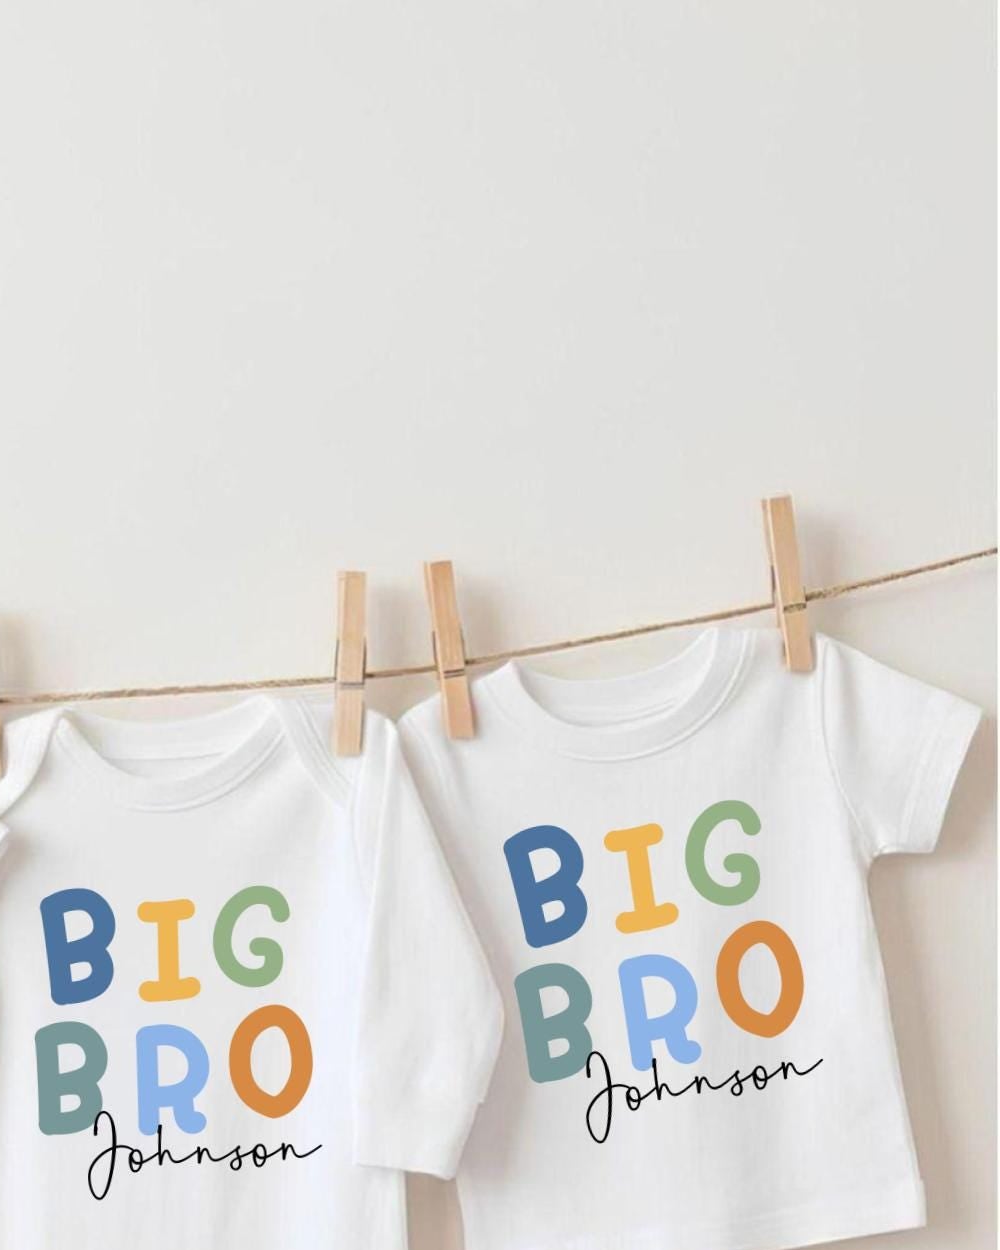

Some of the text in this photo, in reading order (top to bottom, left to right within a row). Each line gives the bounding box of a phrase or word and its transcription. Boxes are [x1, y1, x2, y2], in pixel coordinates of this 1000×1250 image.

[503, 800, 761, 948] BIG
[40, 885, 290, 1005] BIG
[514, 920, 804, 1084] BRO
[34, 1005, 313, 1136] BRO
[585, 1051, 823, 1144] Johnson
[87, 1110, 322, 1201] Johnson
